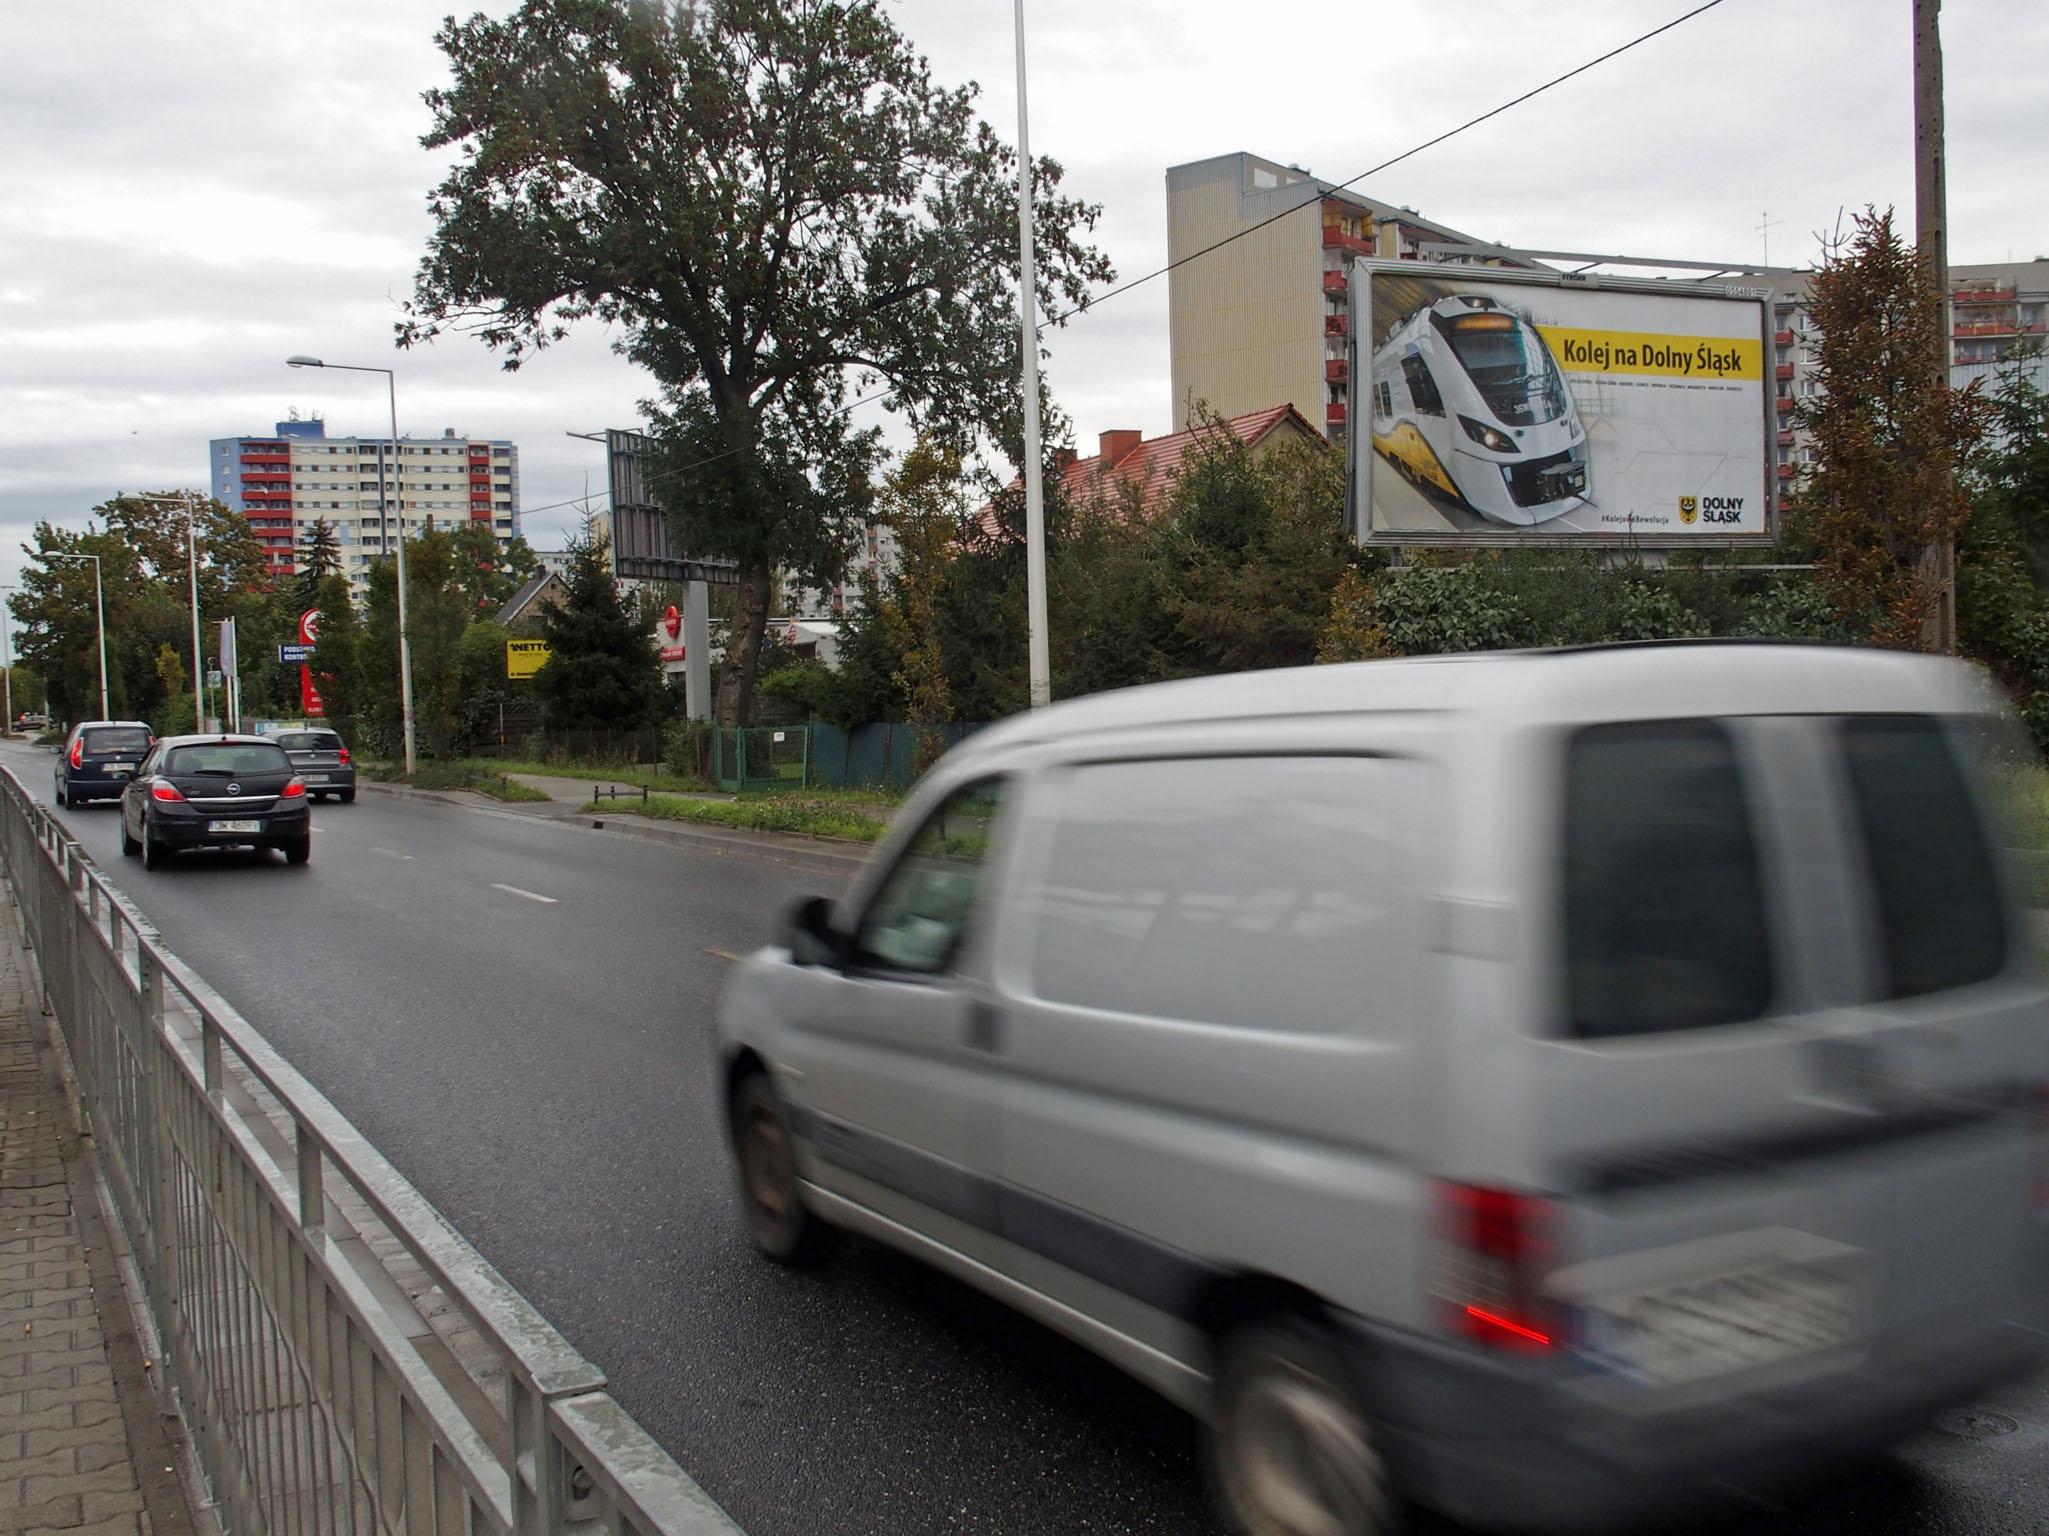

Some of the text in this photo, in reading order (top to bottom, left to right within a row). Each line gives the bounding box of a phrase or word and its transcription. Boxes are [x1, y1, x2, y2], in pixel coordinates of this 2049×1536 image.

[1563, 339, 1742, 376] Kolej na Dolny Śląsk
[1702, 497, 1744, 510] DOLNY
[1702, 508, 1741, 525] ŚLĄSK
